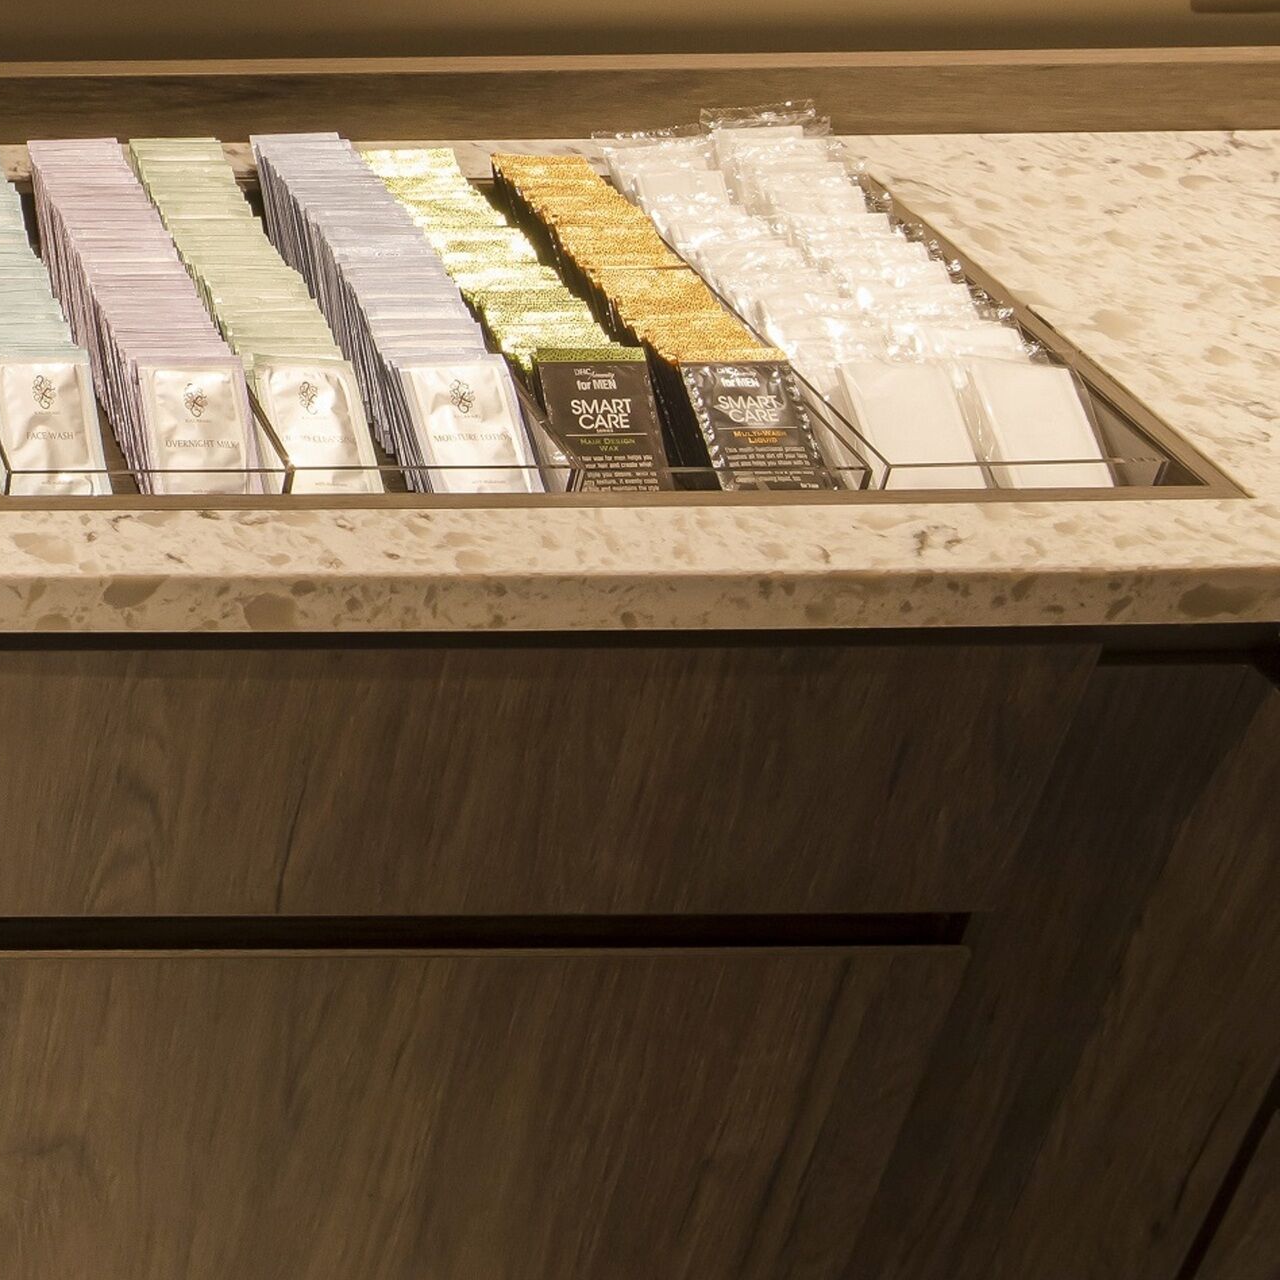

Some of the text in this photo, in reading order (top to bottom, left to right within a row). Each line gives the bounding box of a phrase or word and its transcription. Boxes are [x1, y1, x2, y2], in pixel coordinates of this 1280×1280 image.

[576, 379, 617, 390] for MEN
[570, 398, 631, 415] SMART
[717, 395, 778, 410] SMART
[578, 413, 631, 430] CARE
[728, 408, 780, 422] CARE
[26, 431, 74, 440] FACE WASH
[165, 439, 215, 448] OVERNIGHT
